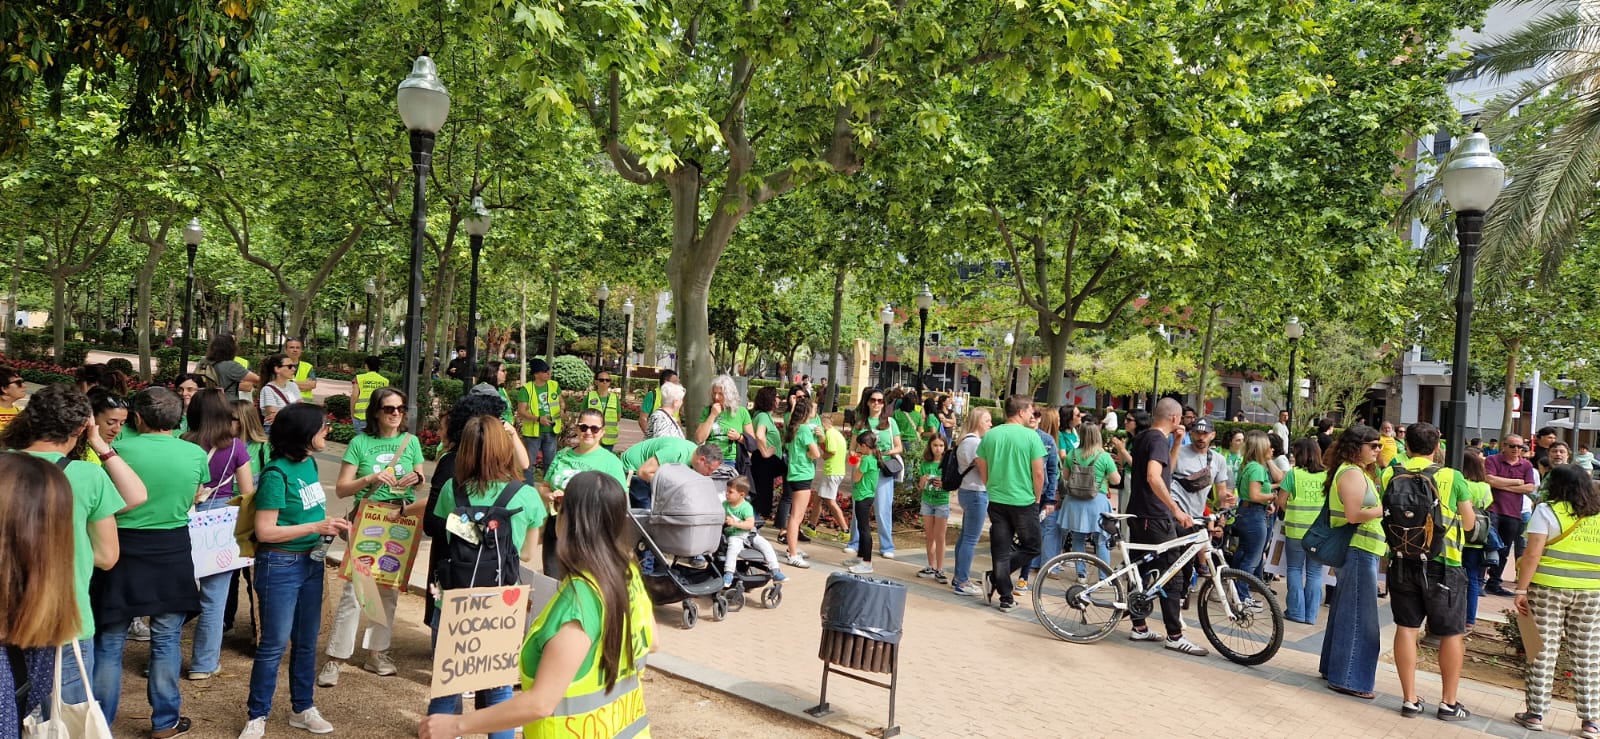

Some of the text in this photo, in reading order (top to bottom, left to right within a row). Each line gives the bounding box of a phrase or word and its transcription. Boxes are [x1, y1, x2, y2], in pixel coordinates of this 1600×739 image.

[364, 511, 381, 522] VAGA
[448, 609, 518, 637] VOCACIÓ
[454, 637, 481, 655] NO
